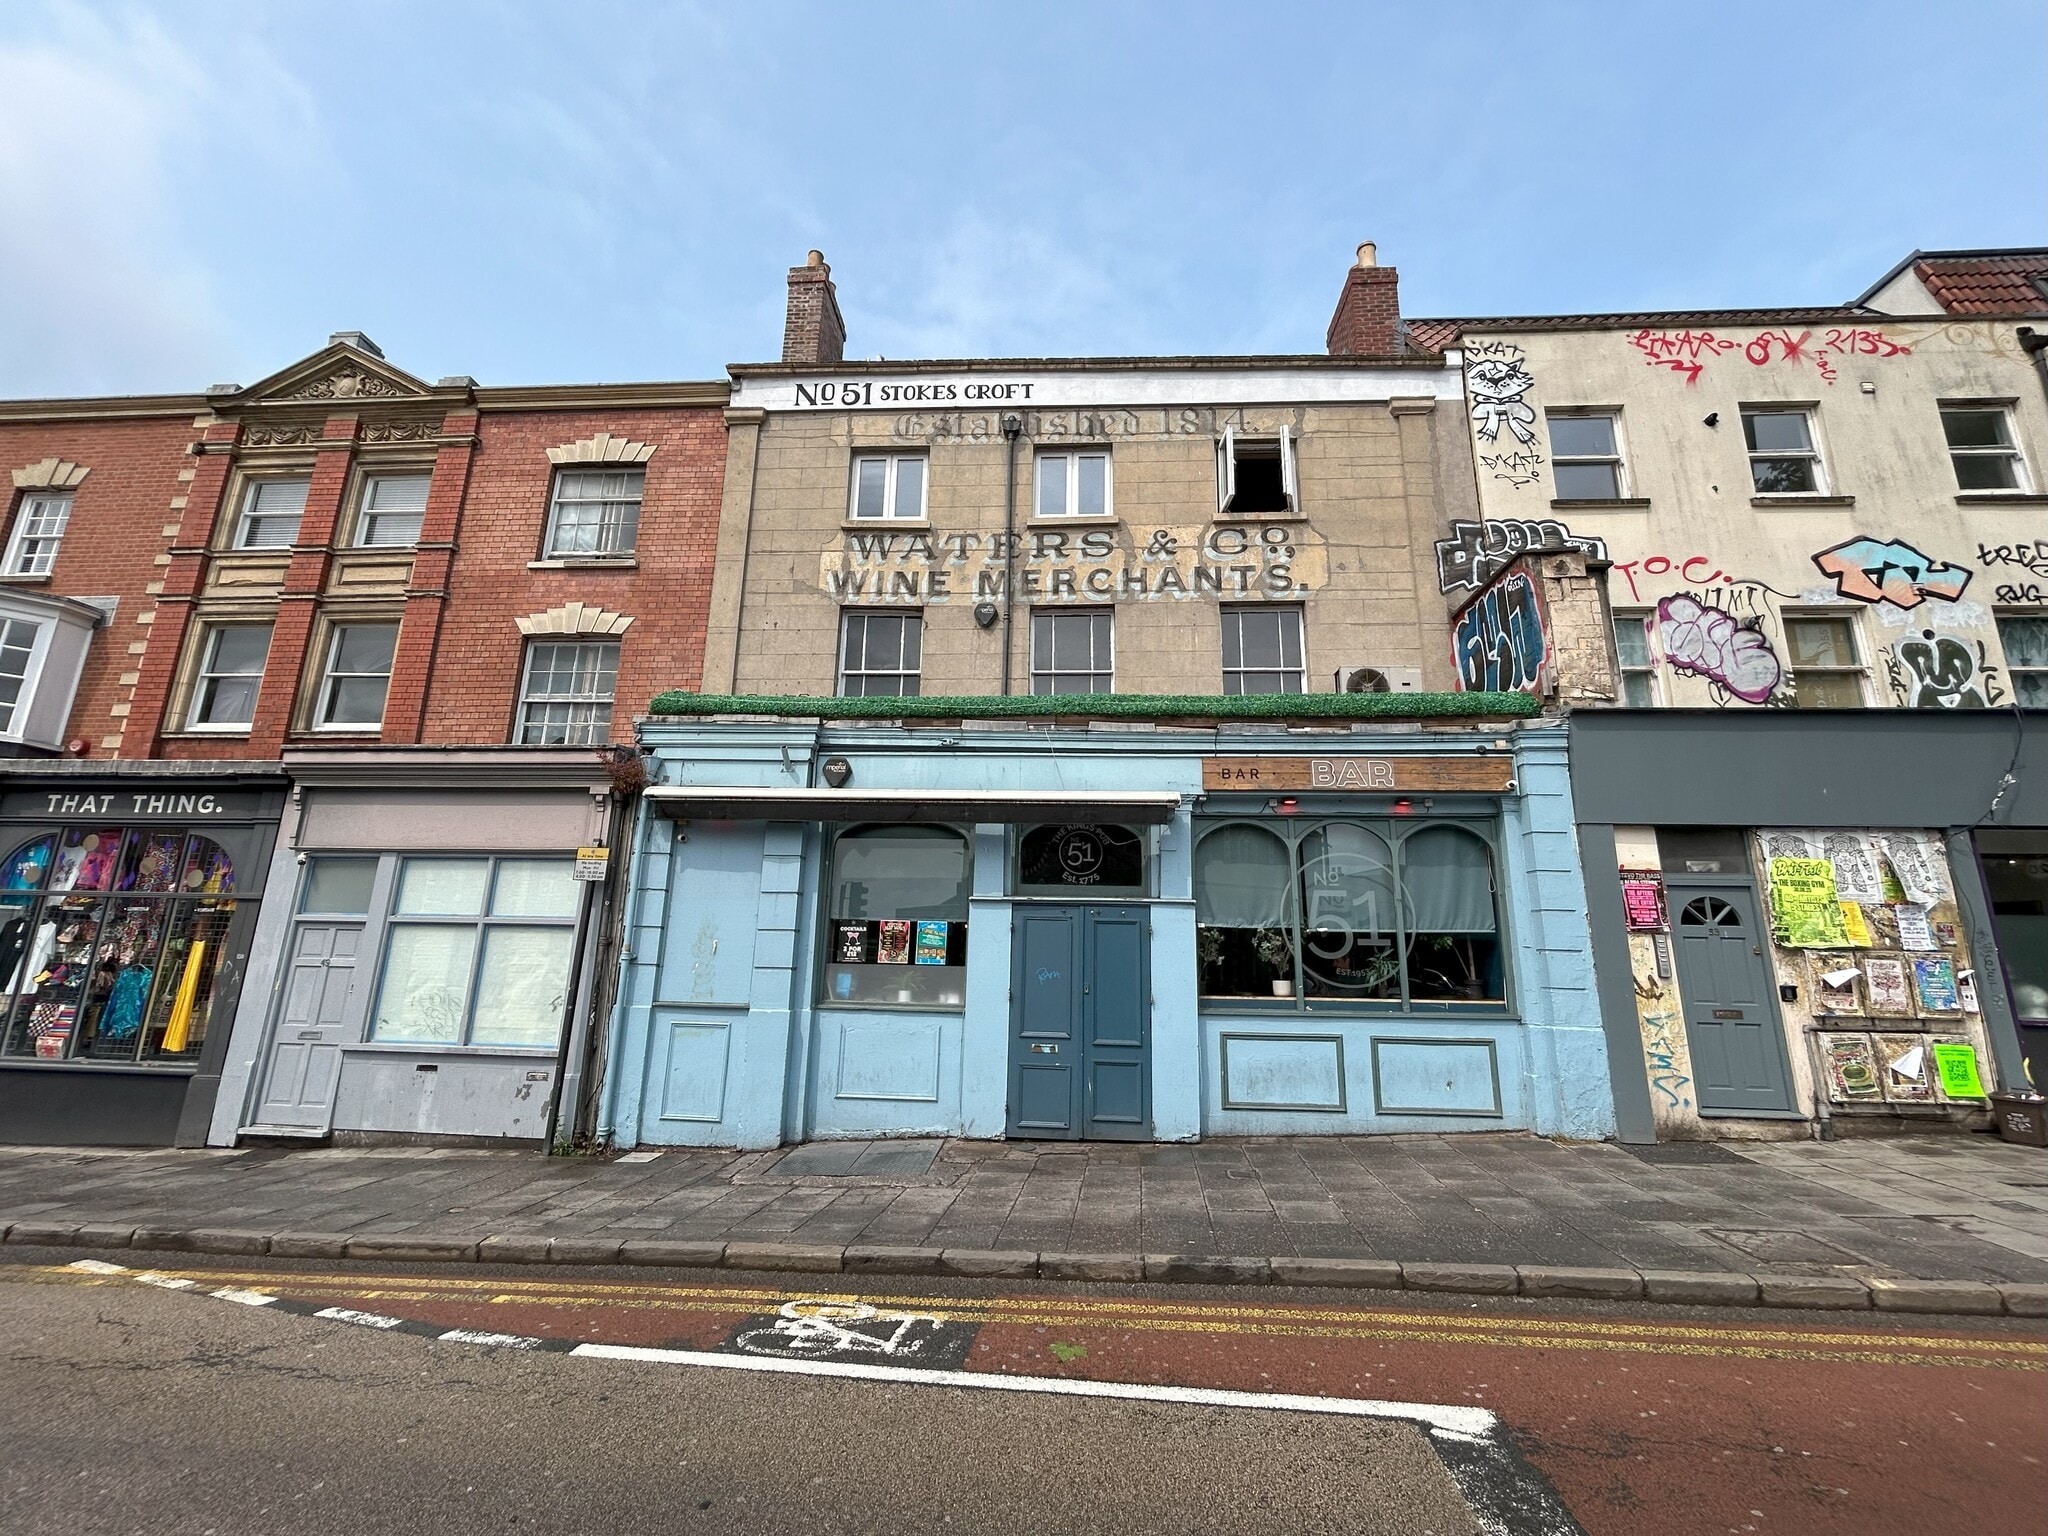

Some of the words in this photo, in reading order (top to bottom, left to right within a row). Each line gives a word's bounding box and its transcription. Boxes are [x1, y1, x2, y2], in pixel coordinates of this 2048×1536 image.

[841, 382, 872, 405] 51
[880, 384, 957, 401] STOKES
[964, 383, 1034, 399] CROFT
[851, 529, 1115, 562] WATERS
[1147, 529, 1178, 556] &
[830, 569, 951, 598] WINE
[1221, 768, 1259, 780] BAR
[1311, 760, 1394, 787] BAR
[48, 794, 114, 813] THAT
[132, 794, 223, 814] THING.
[1052, 826, 1068, 844] THE
[1067, 842, 1095, 866] 51
[1307, 889, 1391, 960] 51
[849, 945, 862, 953] FOR
